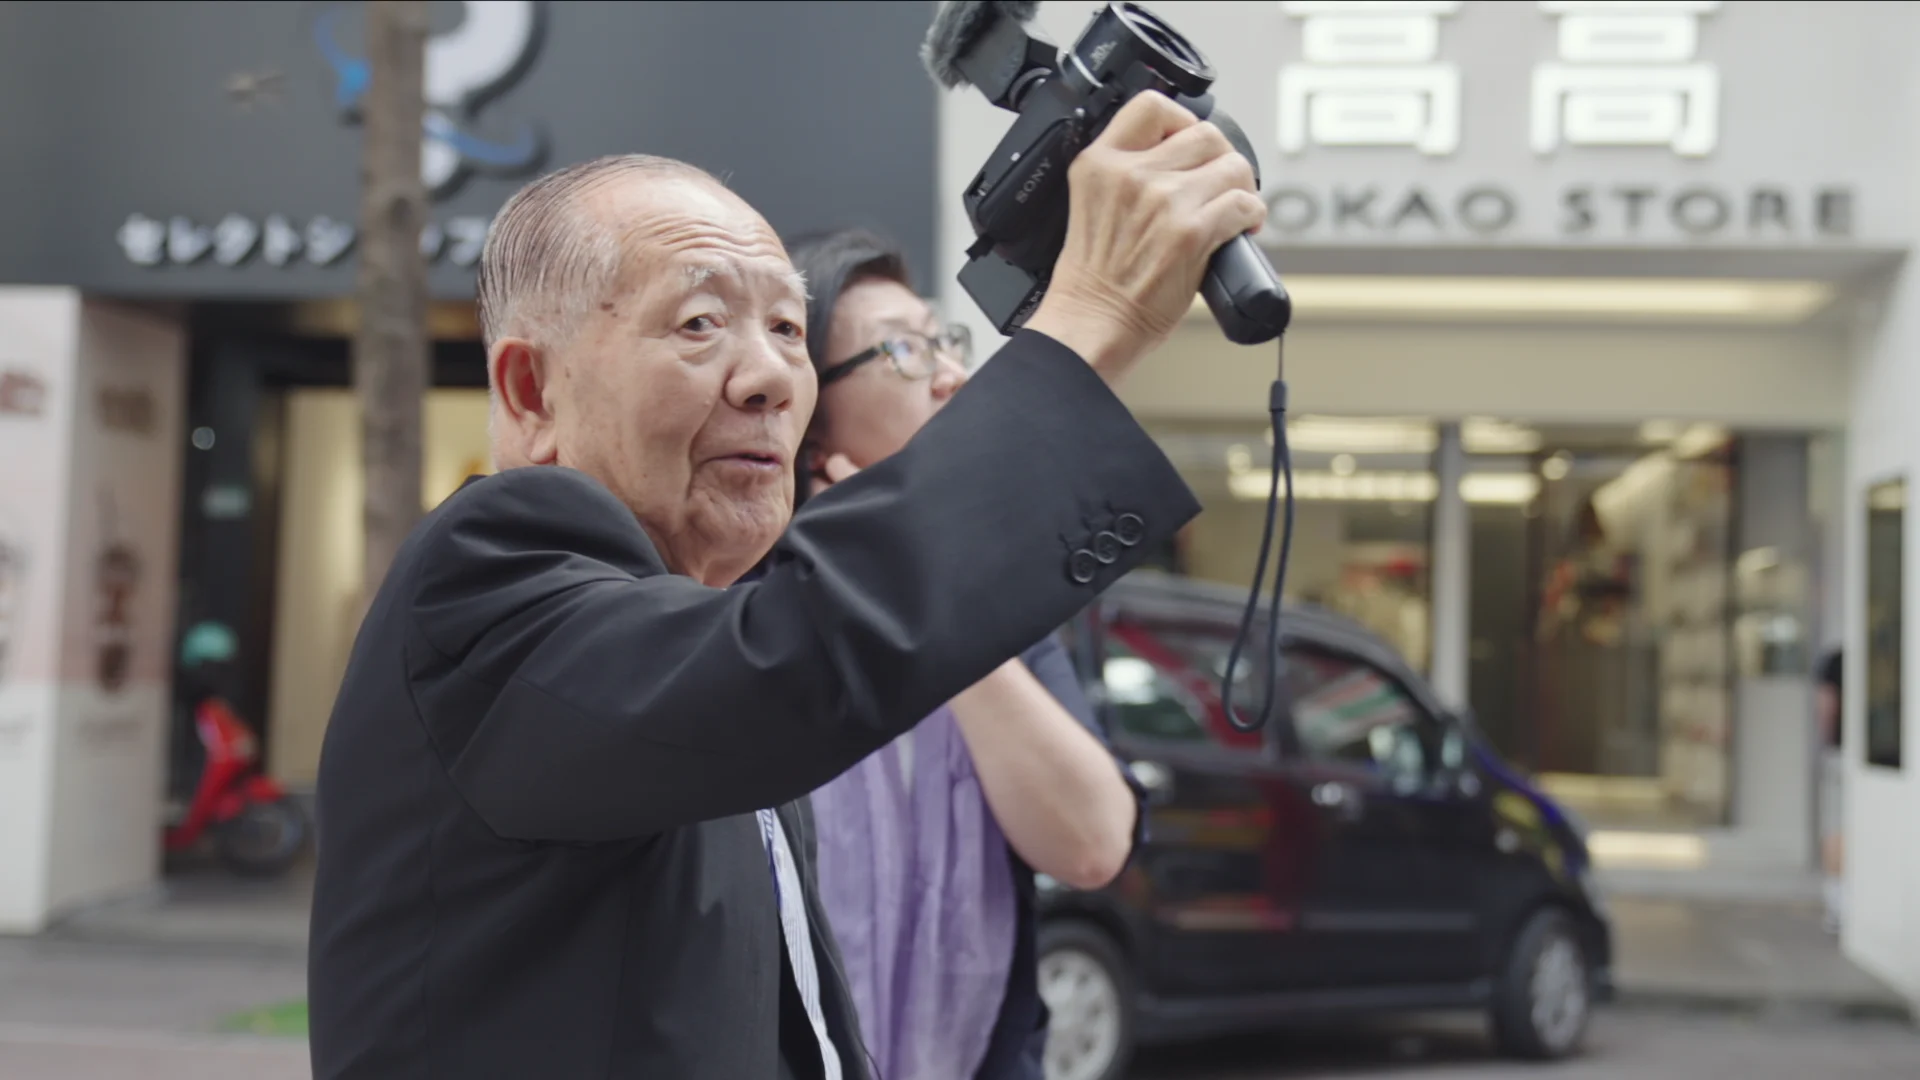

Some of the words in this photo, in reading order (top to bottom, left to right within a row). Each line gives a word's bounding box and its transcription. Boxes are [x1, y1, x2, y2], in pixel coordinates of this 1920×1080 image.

[1015, 157, 1051, 203] SONY
[1267, 186, 1516, 232] OKAO
[1557, 186, 1855, 233] STORE
